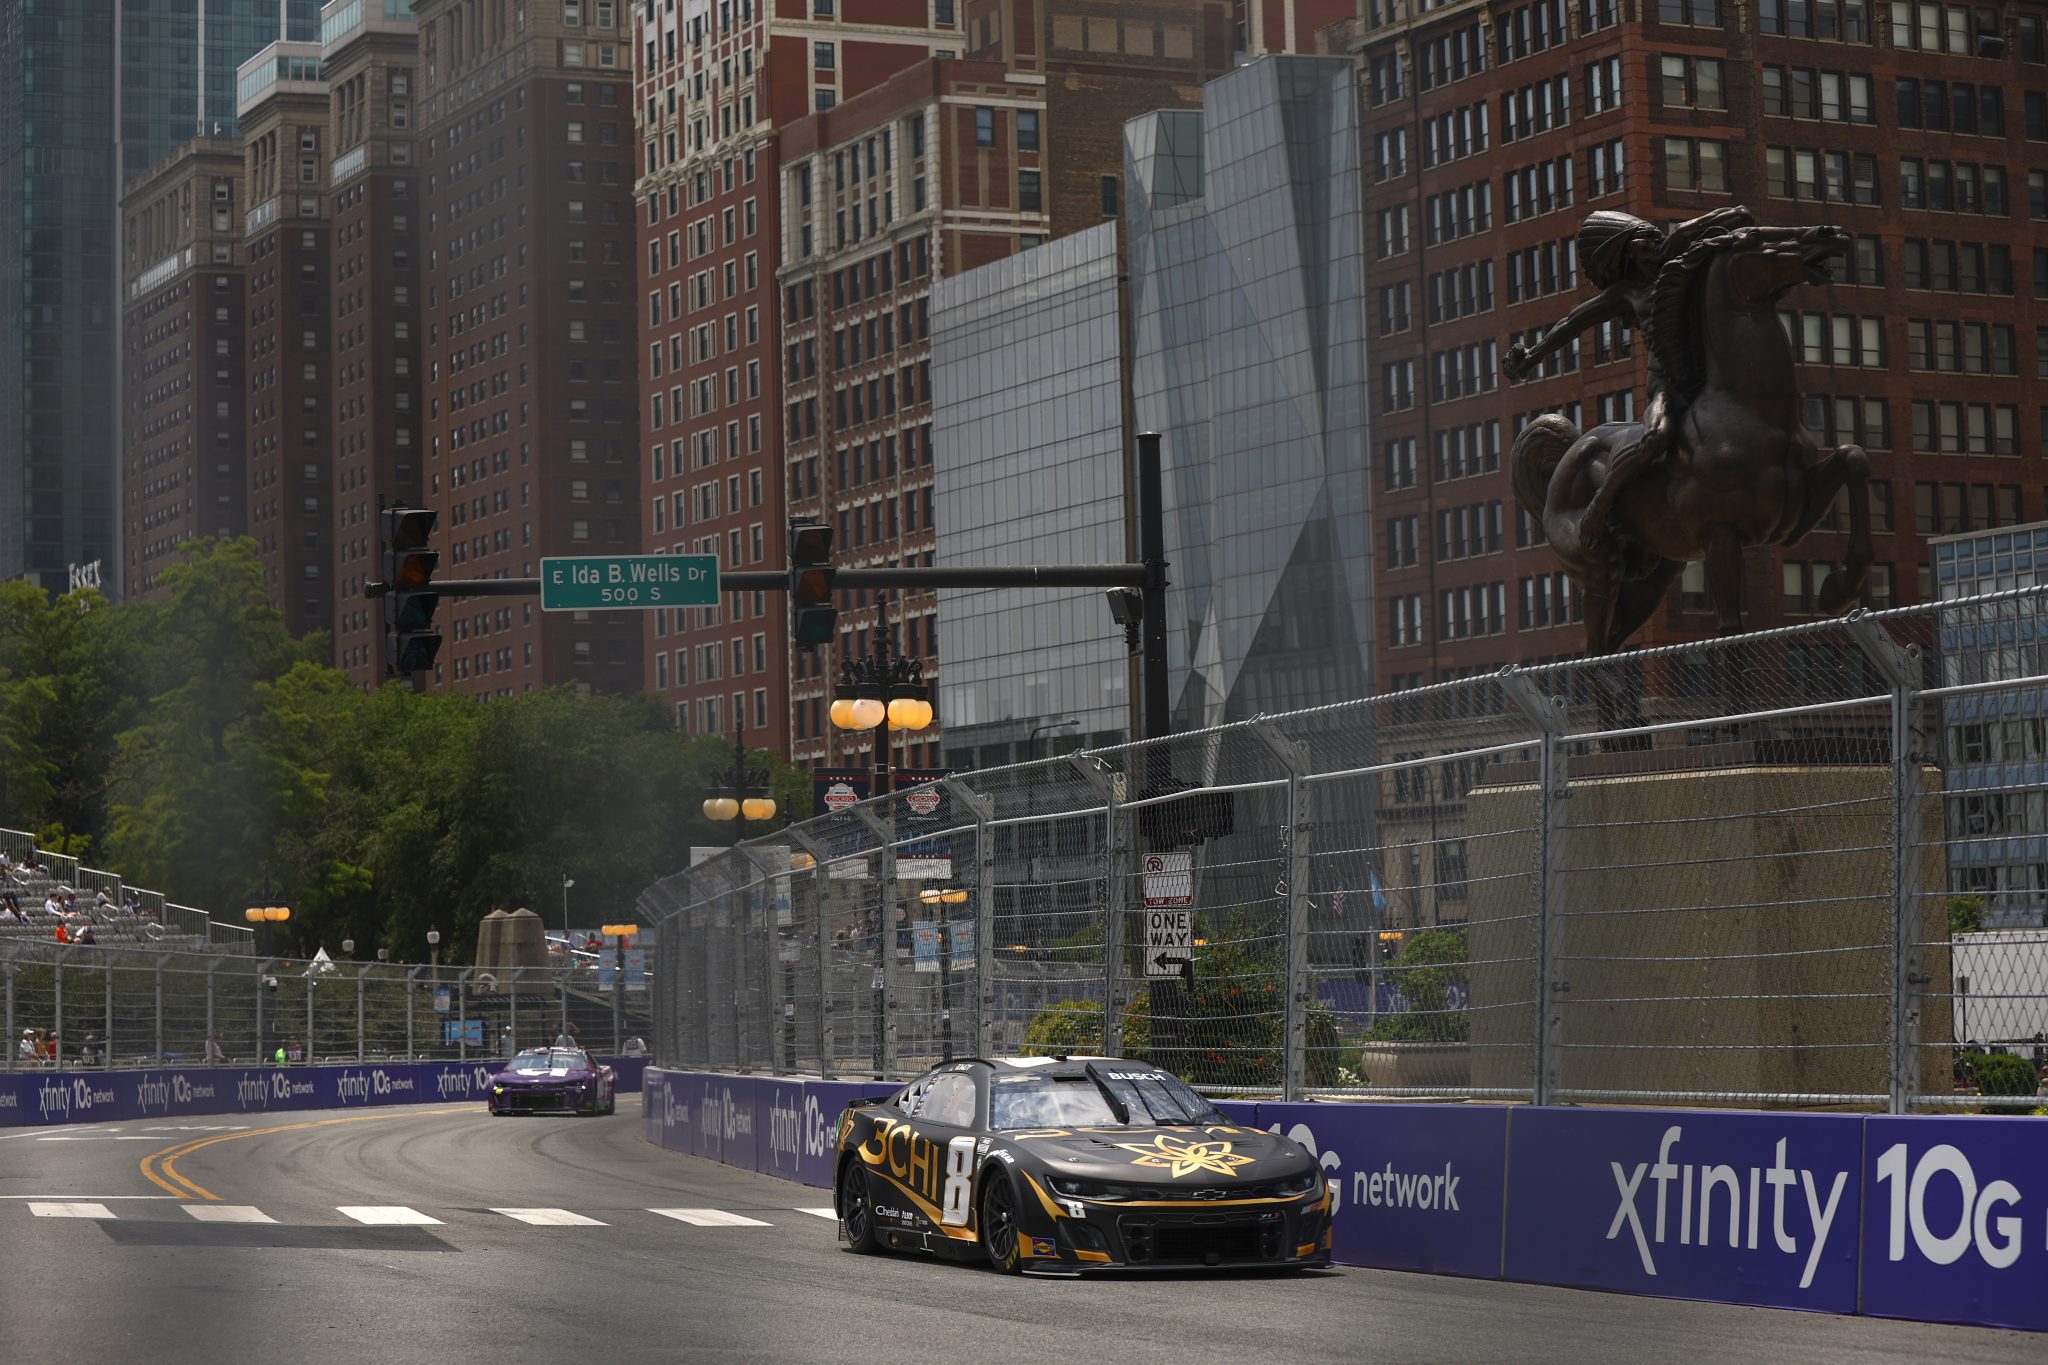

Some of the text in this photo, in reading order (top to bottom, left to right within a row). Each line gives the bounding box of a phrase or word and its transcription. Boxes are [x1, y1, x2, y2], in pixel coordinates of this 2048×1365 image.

[553, 563, 707, 584] E Ida B. Wells Dr
[601, 587, 661, 601] 500 S
[1168, 896, 1188, 904] ZONE
[1150, 932, 1188, 946] WAY
[1151, 913, 1187, 929] ONE
[137, 1073, 170, 1113] xfinity
[172, 1075, 192, 1103] 10G
[237, 1072, 269, 1109] xfinity
[272, 1072, 290, 1099] 10G
[337, 1069, 370, 1104] xfinity
[372, 1070, 391, 1095] 10G
[437, 1066, 471, 1099] xfinity
[1108, 1072, 1166, 1081] BUSCH
[39, 1077, 71, 1120] xfinity
[73, 1078, 92, 1109] 10G
[723, 1088, 736, 1140] 10G
[769, 1088, 802, 1172] xfinity
[805, 1094, 824, 1158] 10G
[858, 1117, 939, 1202] 3CHI
[941, 1136, 977, 1227] 8
[1353, 1161, 1461, 1211] network
[1067, 1201, 1087, 1218] 8
[1606, 1126, 2023, 1288] xfinity 10G
